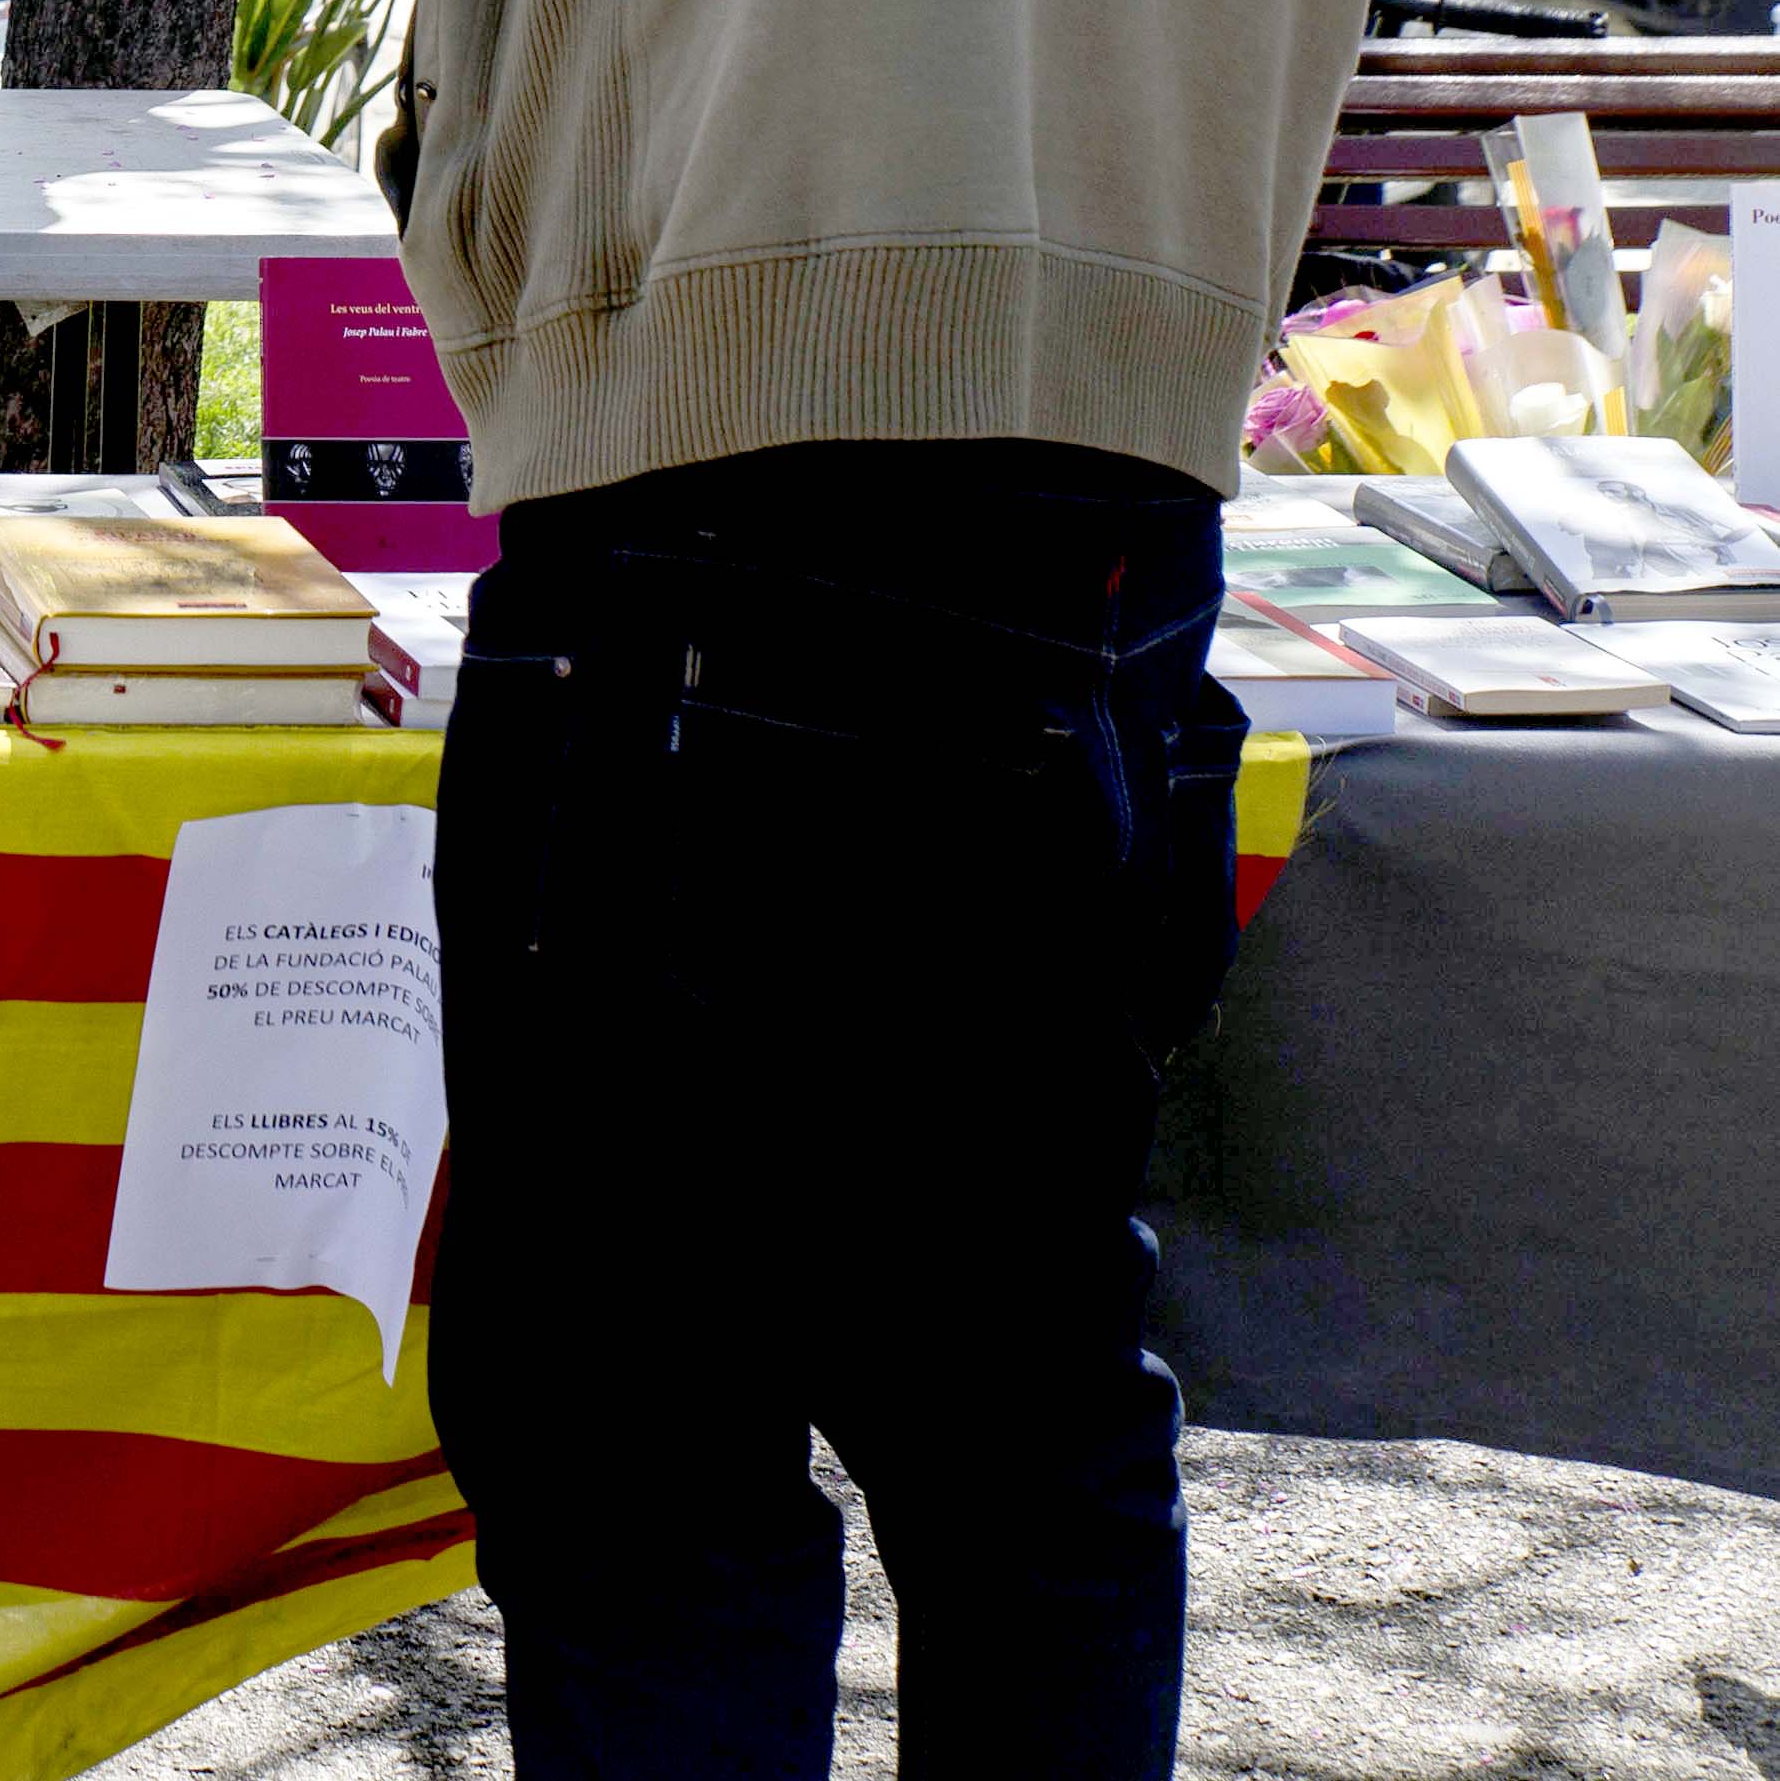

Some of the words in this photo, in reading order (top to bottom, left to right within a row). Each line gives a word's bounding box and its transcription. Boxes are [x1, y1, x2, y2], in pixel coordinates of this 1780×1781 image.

[330, 303, 347, 314] Les
[350, 305, 373, 314] veus
[375, 303, 391, 314] del
[392, 304, 422, 314] ventr
[343, 327, 367, 339] Josep
[368, 327, 395, 337] Palau
[401, 327, 428, 337] Fabre
[225, 924, 257, 941] ELS
[263, 922, 368, 940] CATÀLEGS
[374, 923, 380, 938] I
[388, 924, 441, 965] EDICIO
[214, 955, 239, 971] DE
[246, 953, 269, 968] LA
[276, 949, 384, 968] FUNDACIÓ
[390, 953, 438, 998] PALAU
[207, 982, 249, 1000] 50%
[254, 981, 281, 997] DE
[287, 980, 412, 1007] DESCOMPTE
[254, 1010, 276, 1027] EL
[281, 1009, 335, 1026] PREU
[340, 1009, 421, 1045] MARCAT
[212, 1113, 245, 1130] ELS
[250, 1113, 329, 1129] LLIBRES
[334, 1113, 358, 1130] AL
[365, 1117, 400, 1148] 15%
[181, 1143, 305, 1160] DESCOMPTE
[310, 1143, 376, 1164] SOBRE
[380, 1154, 395, 1178] EL
[275, 1172, 364, 1189] MARCAT
